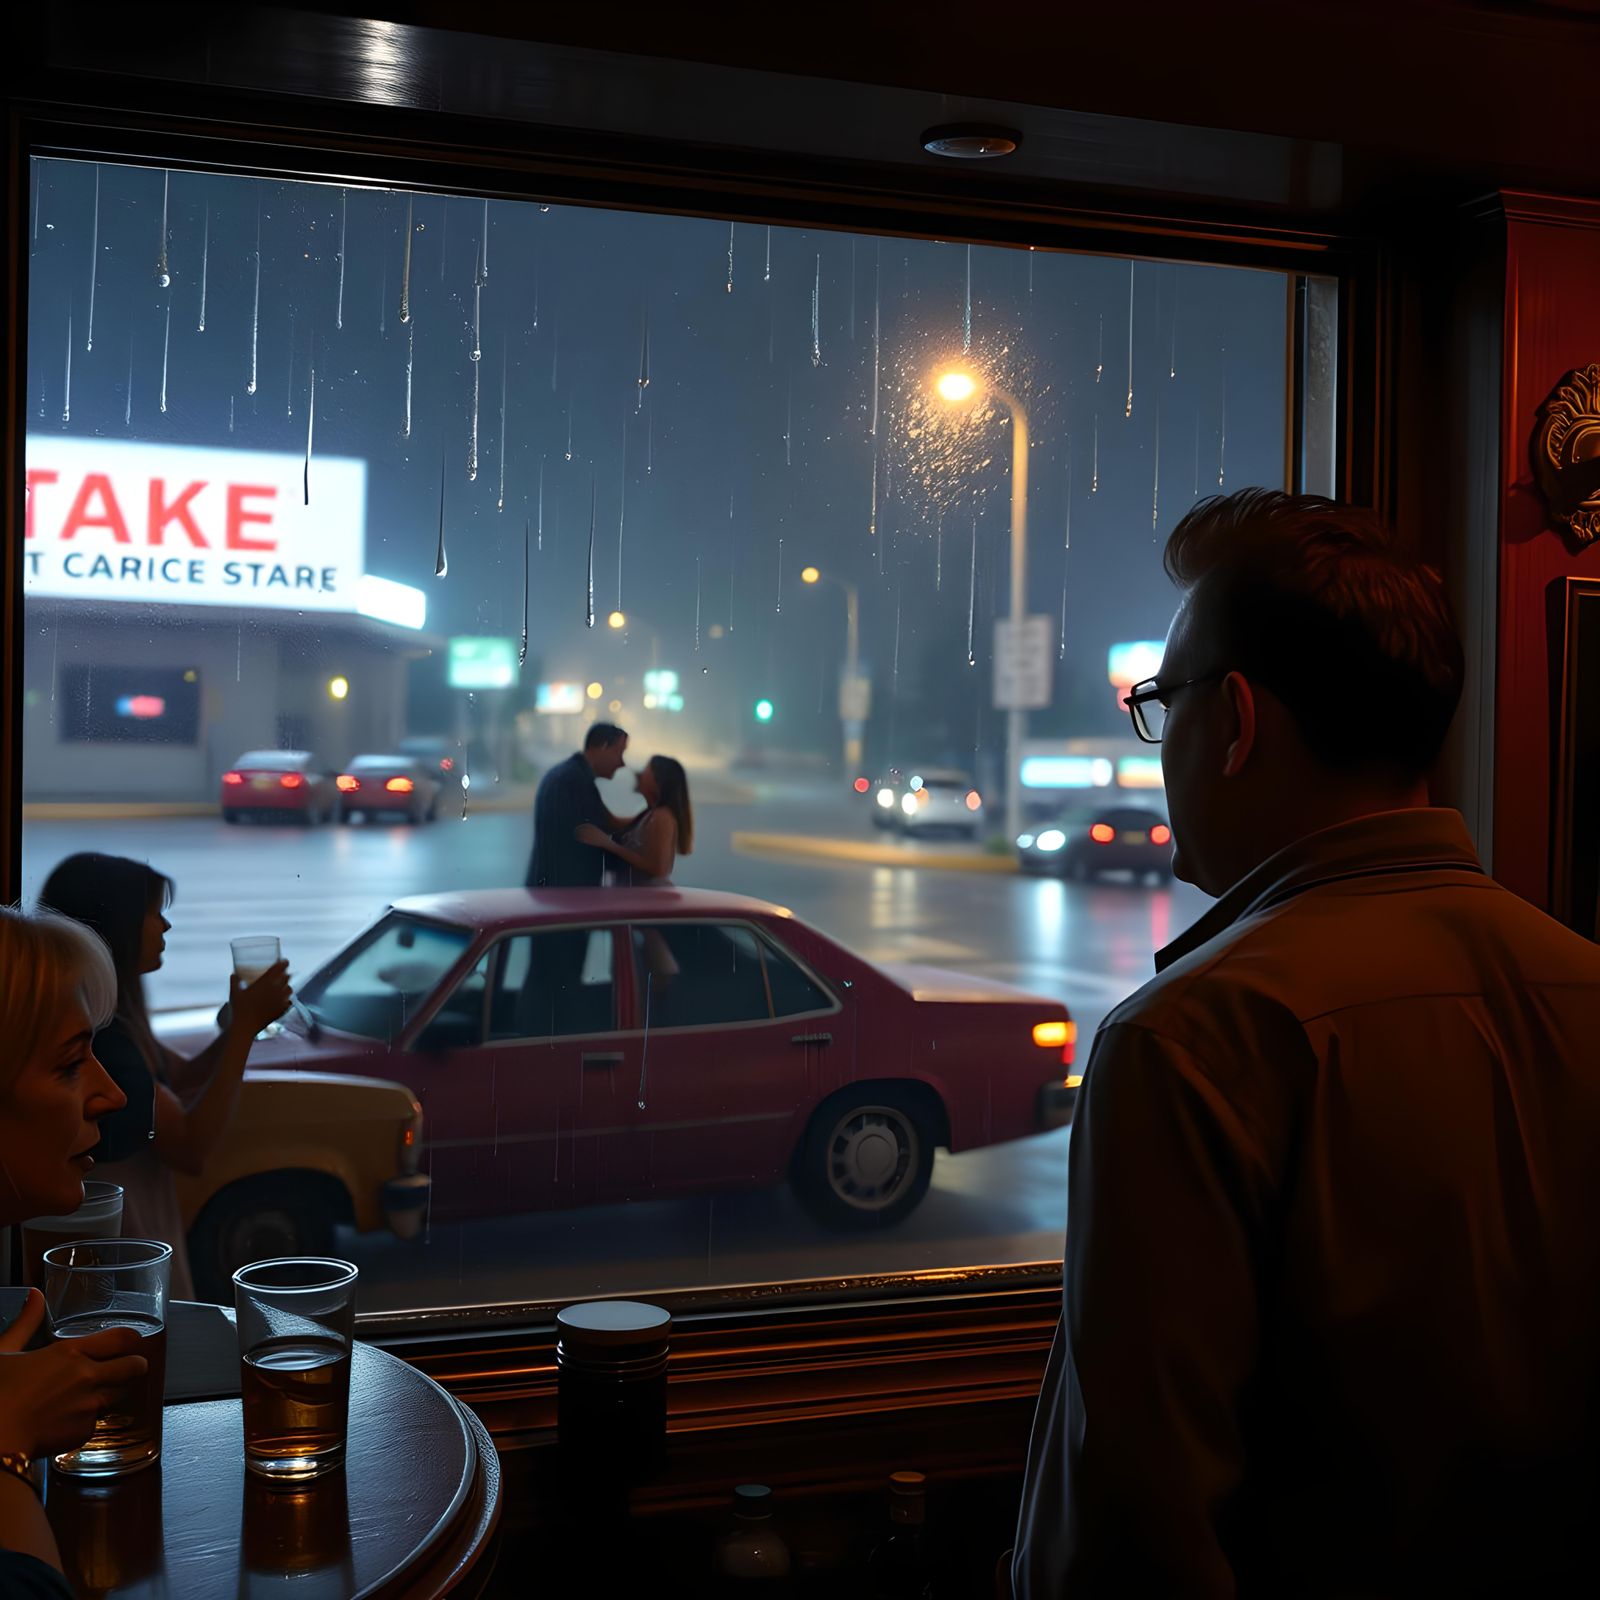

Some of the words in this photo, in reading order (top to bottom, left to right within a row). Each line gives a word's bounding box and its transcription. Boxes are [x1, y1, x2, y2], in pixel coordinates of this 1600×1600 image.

[24, 469, 276, 551] TAKE
[63, 552, 205, 584] CARICE
[223, 562, 337, 592] STARE
